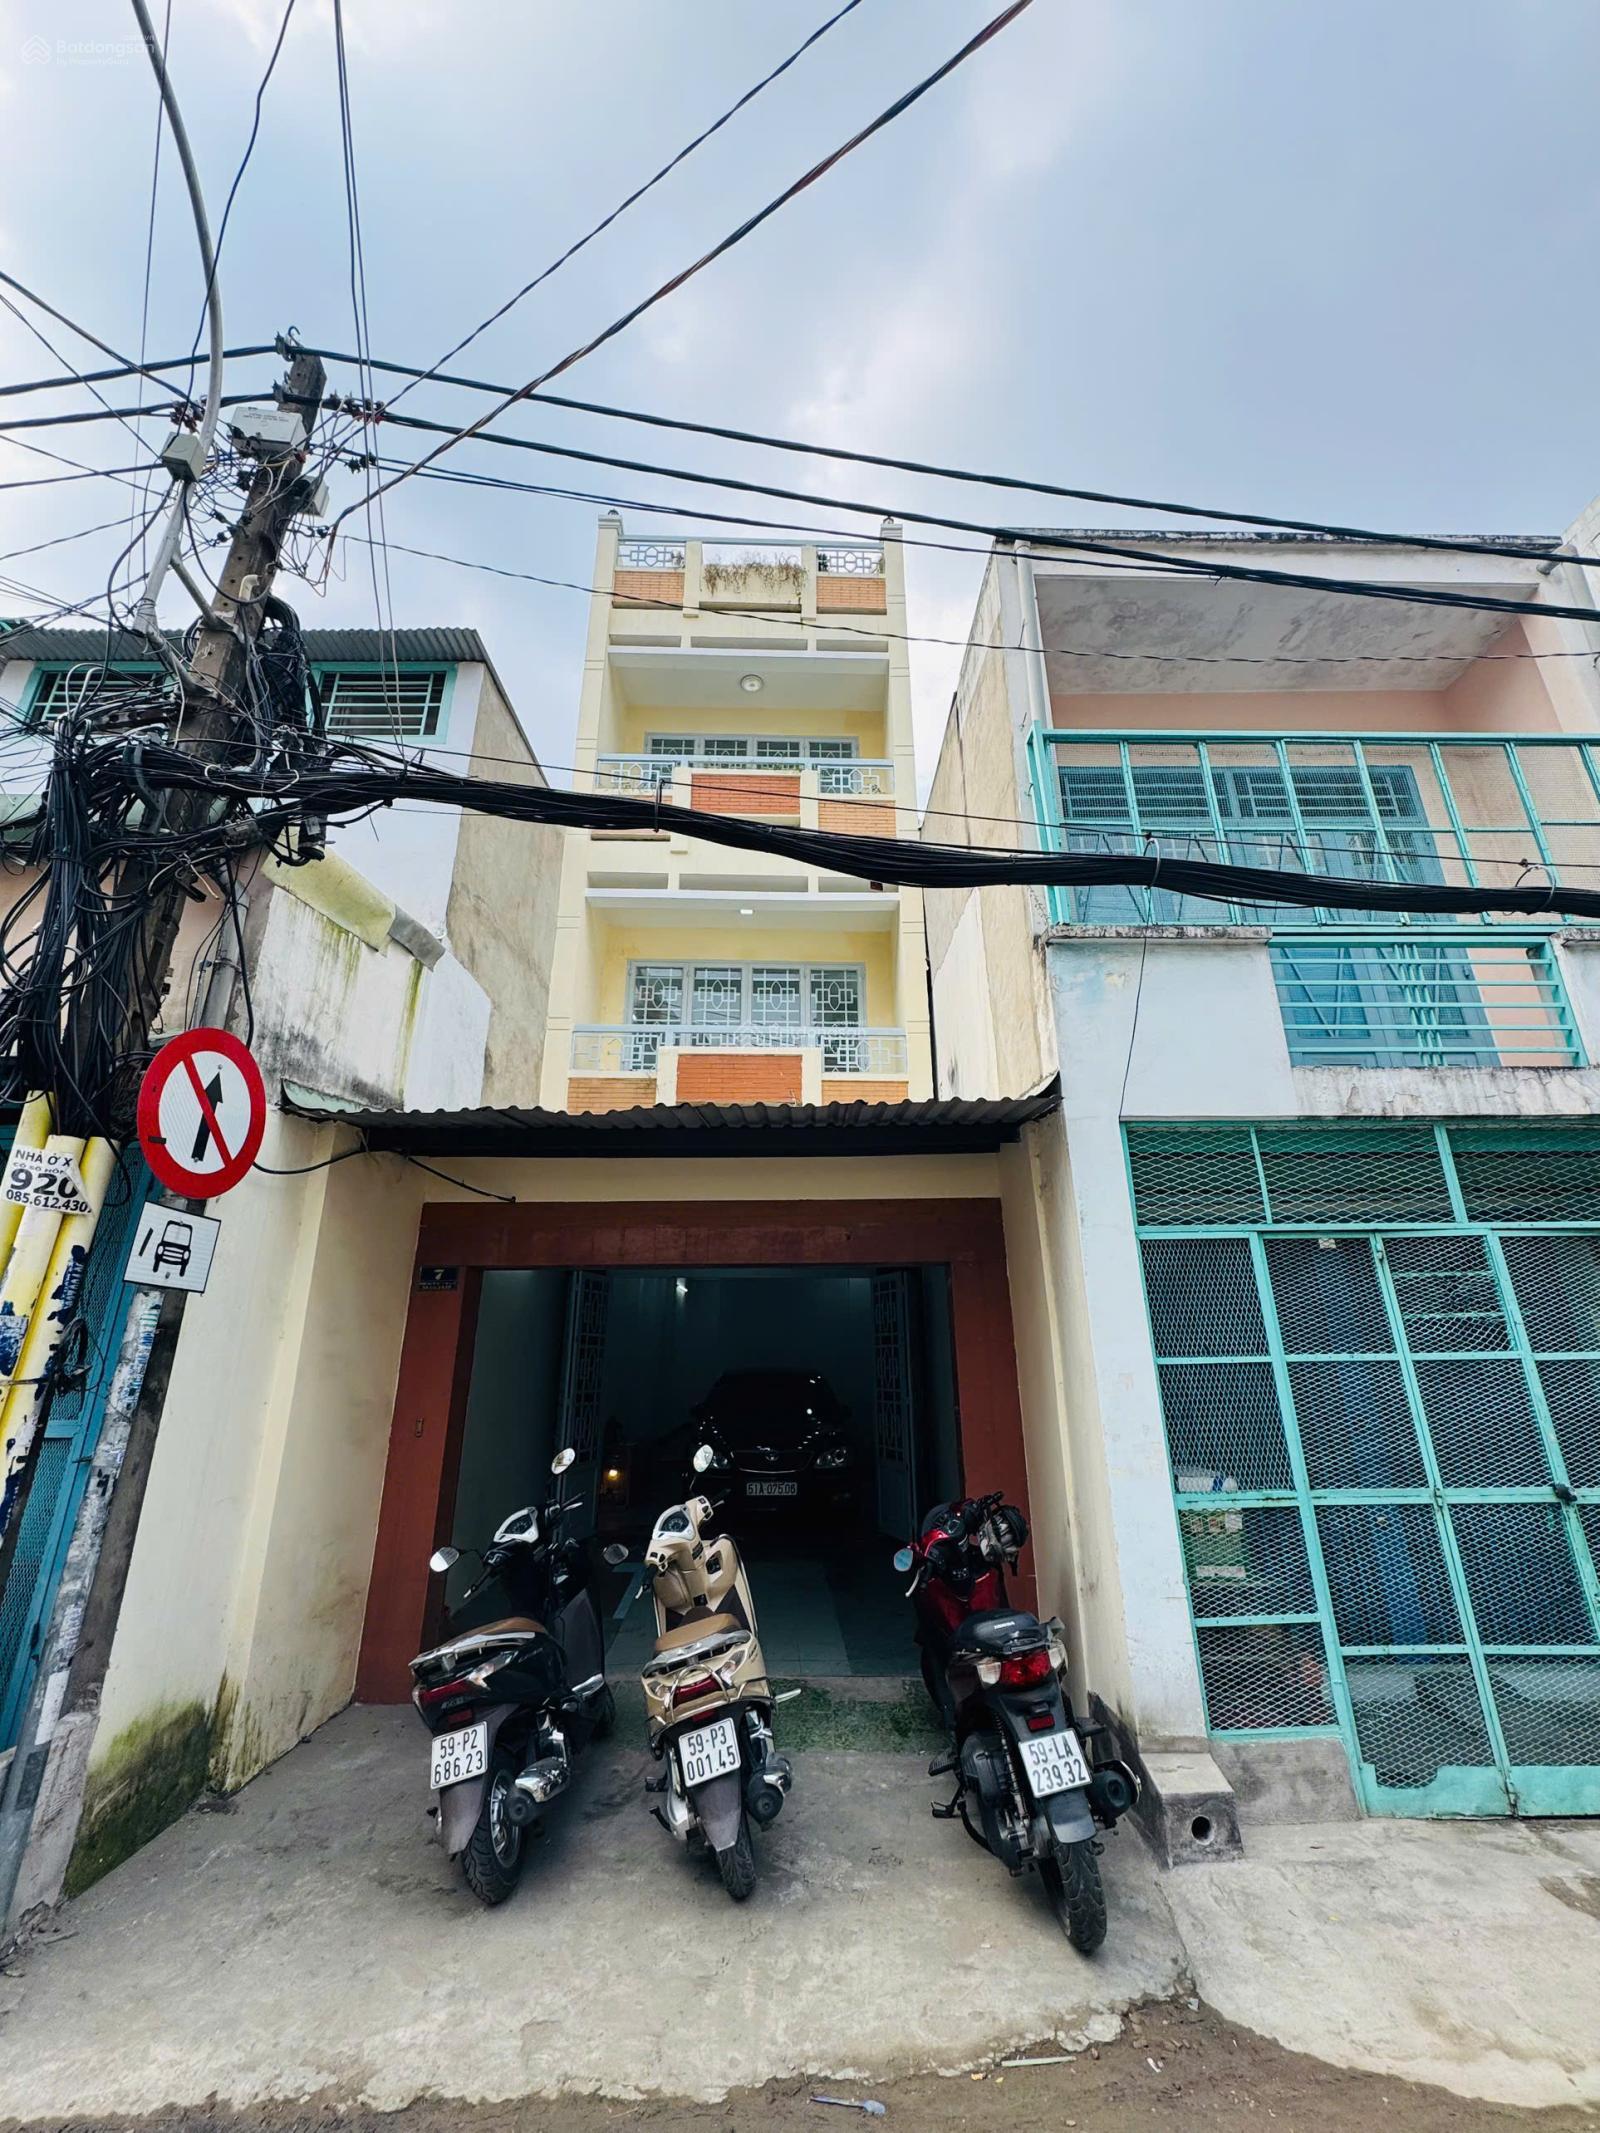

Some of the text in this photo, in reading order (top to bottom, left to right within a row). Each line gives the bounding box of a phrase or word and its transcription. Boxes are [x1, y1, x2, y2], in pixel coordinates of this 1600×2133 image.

[6, 1189, 92, 1214] 085.612.430
[433, 1269, 445, 1280] 7
[440, 1729, 478, 1759] 59-P2
[687, 1725, 727, 1756] 59-P3
[434, 1750, 483, 1784] 686.23
[687, 1745, 736, 1781] 001.45
[1032, 1758, 1086, 1793] 239.32
